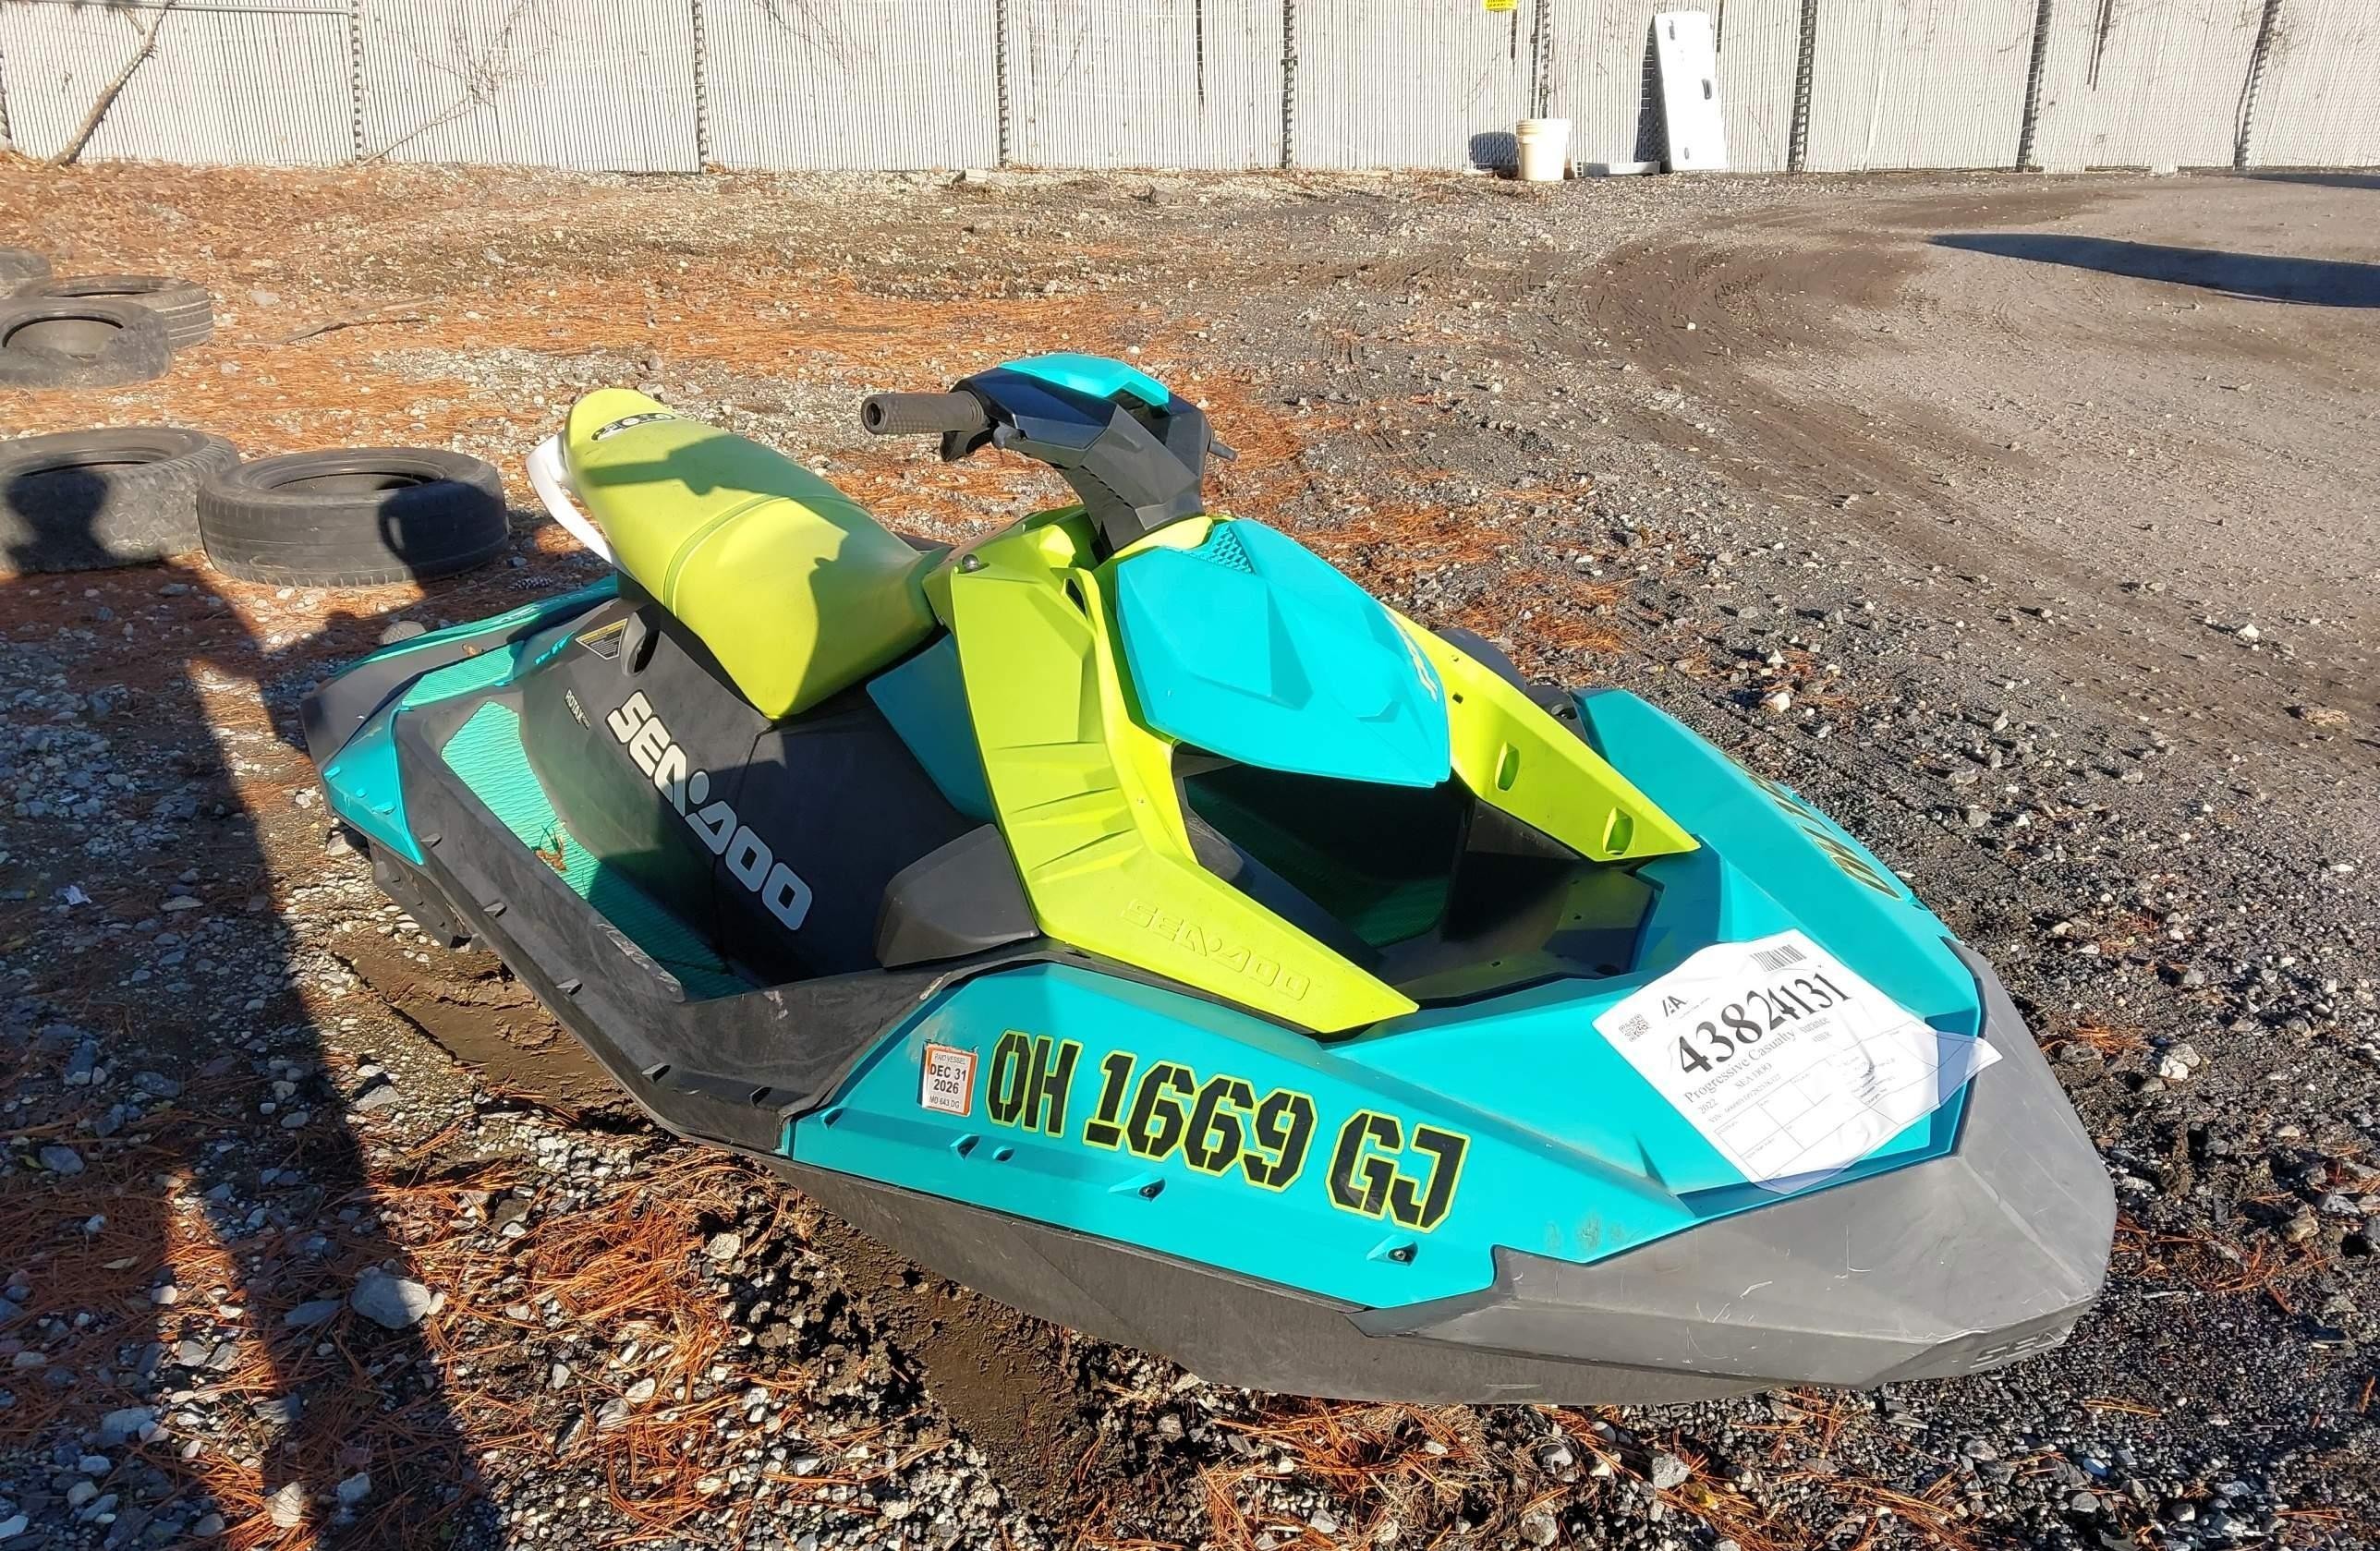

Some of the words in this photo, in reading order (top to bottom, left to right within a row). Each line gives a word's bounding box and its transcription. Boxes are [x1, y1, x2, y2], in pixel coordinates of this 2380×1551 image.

[565, 688, 584, 723] ROTAX
[1679, 972, 1852, 1073] 43824131
[929, 1063, 952, 1079] DEC
[953, 1068, 967, 1082] 31
[1682, 1059, 1751, 1103] Progressive
[1748, 1028, 1797, 1060] Casualty
[933, 1078, 960, 1095] 2026
[1698, 1098, 1719, 1114] 2022
[987, 1029, 1083, 1138] OH
[1083, 1050, 1319, 1193] 1669
[1325, 1109, 1472, 1234] GJ
